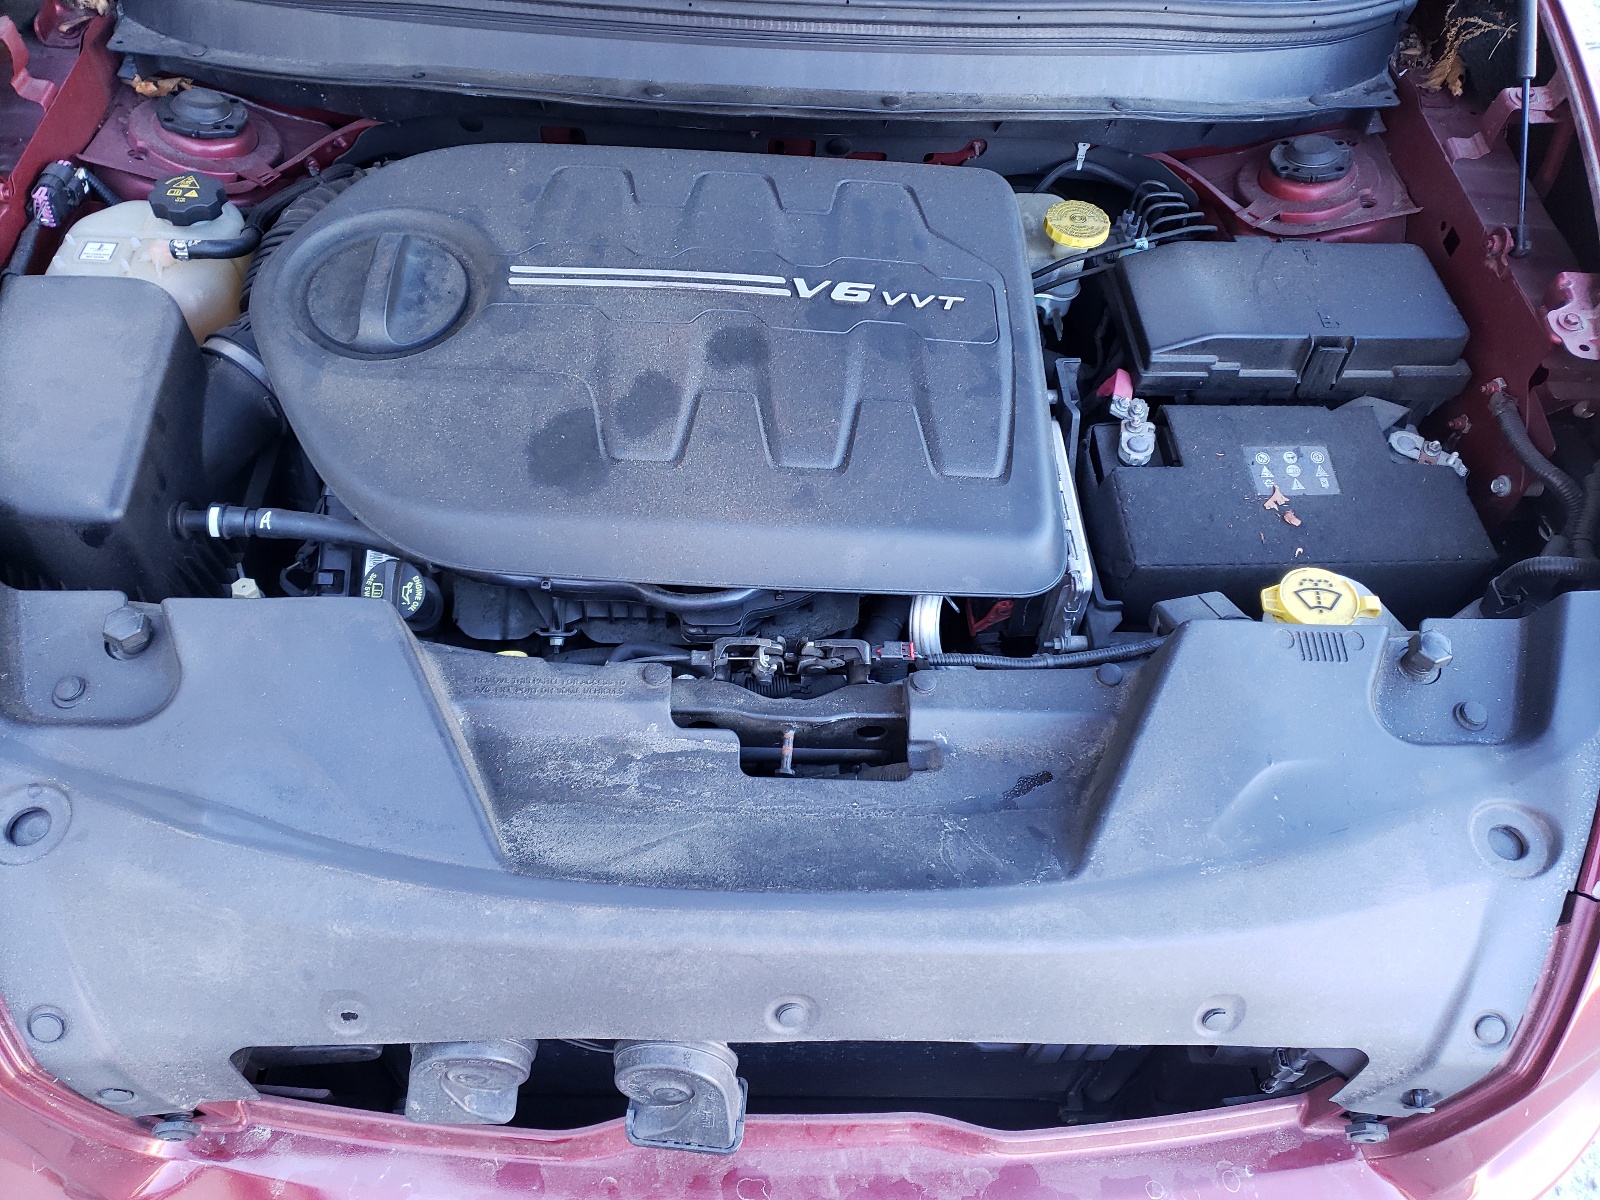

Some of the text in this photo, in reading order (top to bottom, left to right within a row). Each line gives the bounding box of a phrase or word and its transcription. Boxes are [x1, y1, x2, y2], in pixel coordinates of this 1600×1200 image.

[793, 277, 966, 311] V6 VVT
[259, 510, 272, 530] A
[365, 572, 378, 586] SAE
[407, 575, 424, 612] ENGINE OIL
